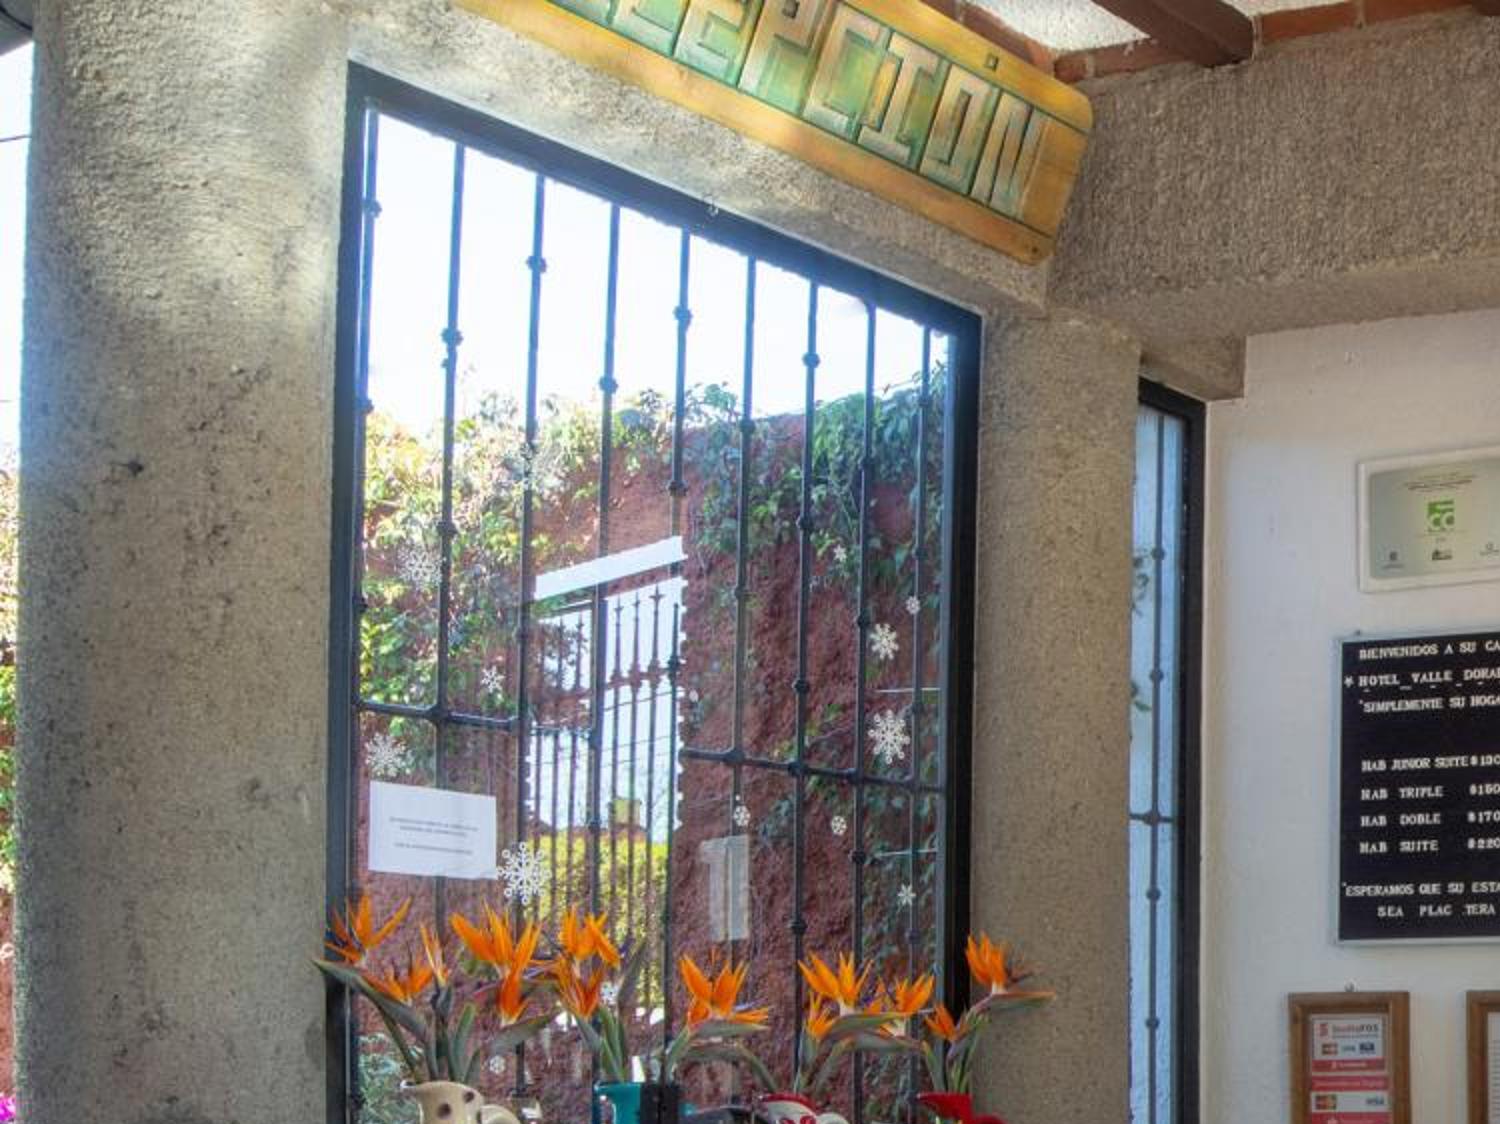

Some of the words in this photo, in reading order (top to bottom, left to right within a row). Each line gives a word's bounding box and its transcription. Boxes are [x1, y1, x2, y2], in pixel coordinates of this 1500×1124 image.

[1359, 643, 1439, 660] BIENVENIDOS
[1443, 644, 1454, 655] A
[1459, 642, 1477, 653] SU
[1359, 674, 1400, 687] HOTEL
[1411, 670, 1453, 684] VALLE
[1449, 696, 1466, 708] SU
[1361, 760, 1387, 772] HAB
[1391, 757, 1431, 771] JUNIOR
[1434, 755, 1469, 769] SUITE
[1361, 788, 1388, 800] HAB
[1399, 785, 1444, 798] TRIPLE
[1360, 815, 1387, 827] HAB
[1399, 813, 1441, 826] DOBLE
[1359, 841, 1388, 853] HAB
[1399, 840, 1440, 852] SUITE
[1447, 883, 1464, 894] SU
[1377, 905, 1404, 917] SEA
